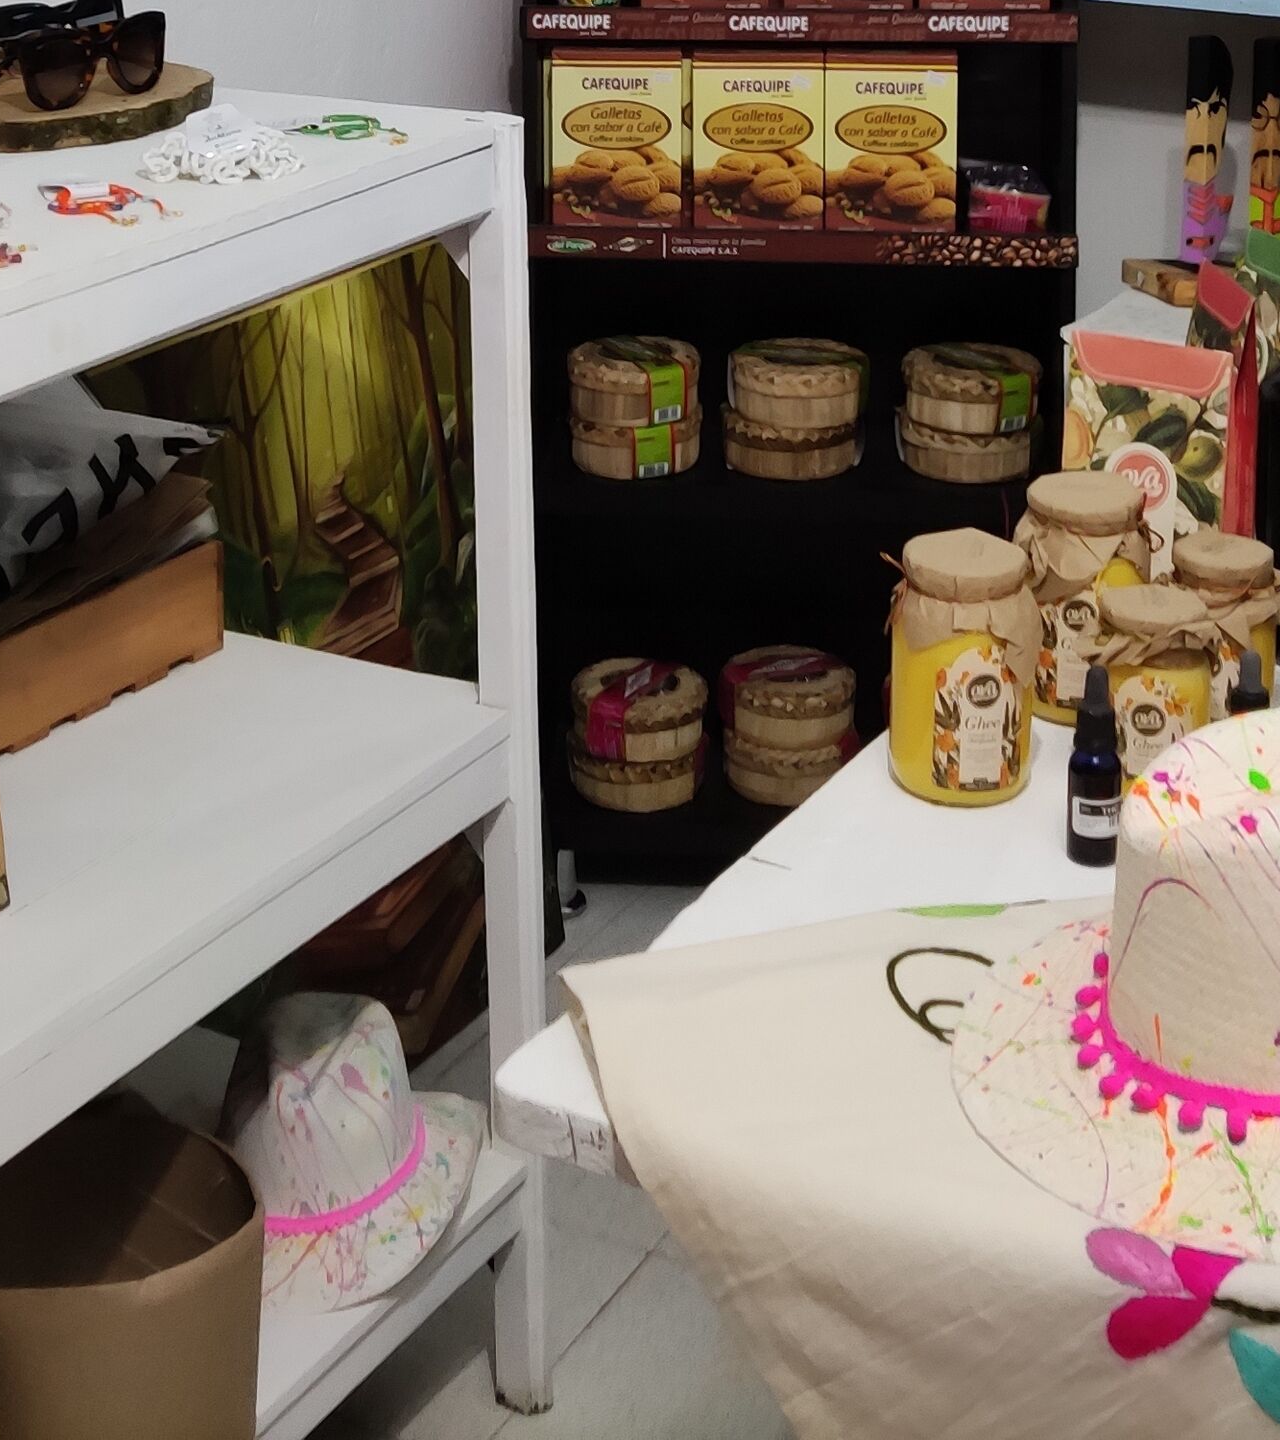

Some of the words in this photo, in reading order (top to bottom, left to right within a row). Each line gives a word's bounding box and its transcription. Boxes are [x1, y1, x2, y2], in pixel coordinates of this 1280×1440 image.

[532, 13, 611, 30] CAFEQUIPE
[729, 15, 809, 32] CAFEQUIPE
[927, 15, 1010, 32] CAFEQUIPE
[581, 77, 649, 90] CAFEQUIPE
[723, 80, 791, 93] CAFEQUIPE
[855, 81, 924, 95] CAFEQUIPE
[590, 107, 642, 120] Galletas
[731, 109, 784, 122] Galletas
[864, 111, 917, 125] Galletas
[570, 123, 590, 132] con
[593, 122, 624, 133] sabor
[626, 124, 634, 133] a
[636, 121, 662, 133] Café
[711, 126, 732, 135] con
[735, 124, 765, 136] sabor
[768, 126, 775, 136] a
[778, 124, 804, 136] Café
[844, 127, 864, 137] con
[867, 126, 898, 137] sabor
[900, 128, 908, 137] a
[911, 125, 937, 138] Café
[671, 246, 716, 256] CAFEQUIPE
